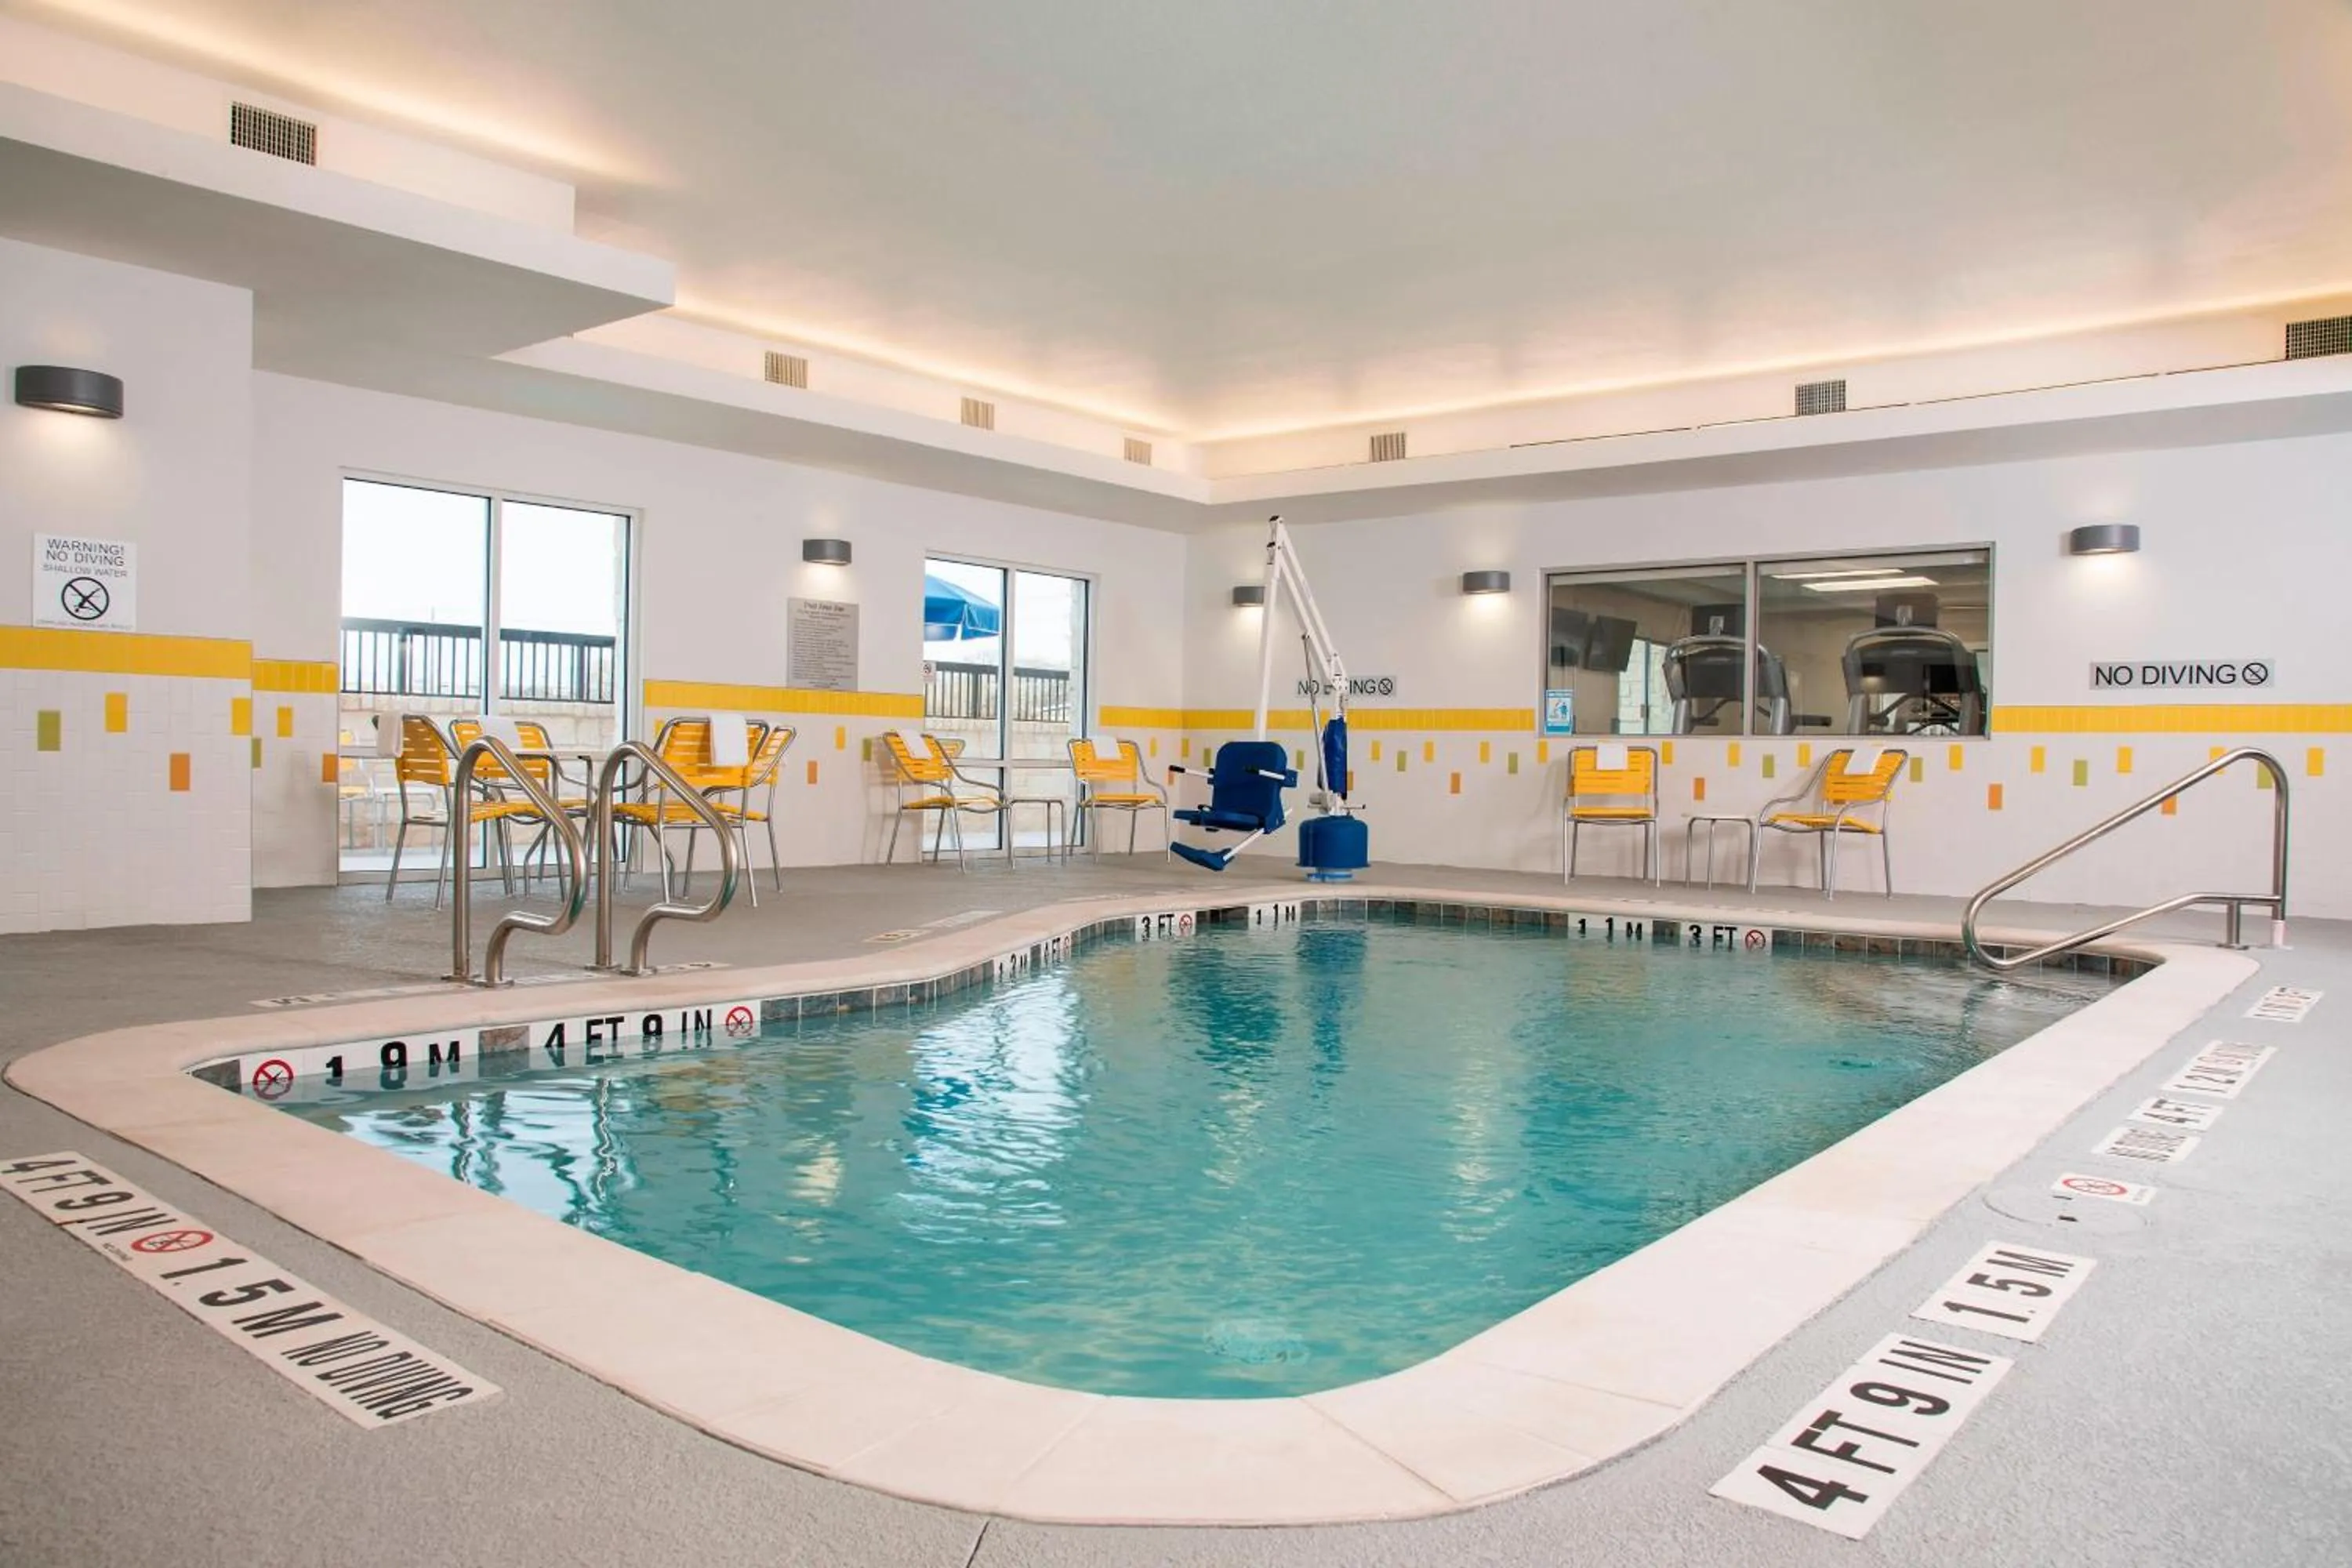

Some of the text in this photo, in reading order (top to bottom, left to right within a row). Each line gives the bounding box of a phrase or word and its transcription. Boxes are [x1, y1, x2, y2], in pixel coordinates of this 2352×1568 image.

[48, 539, 125, 555] WARNING!
[46, 550, 124, 567] NO DIVING
[43, 564, 127, 578] SHALLOW WATER
[2095, 664, 2237, 686] NO DIVING
[1298, 680, 1376, 695] NO ING
[586, 1016, 625, 1044] FT
[682, 1009, 712, 1034] IN
[429, 1041, 460, 1065] M
[16, 1170, 113, 1193] FT
[54, 1192, 135, 1210] 9
[78, 1207, 177, 1236] IN
[281, 1330, 474, 1420] NO DIVING
[1756, 1340, 1991, 1512] 4 FT 9 IN
